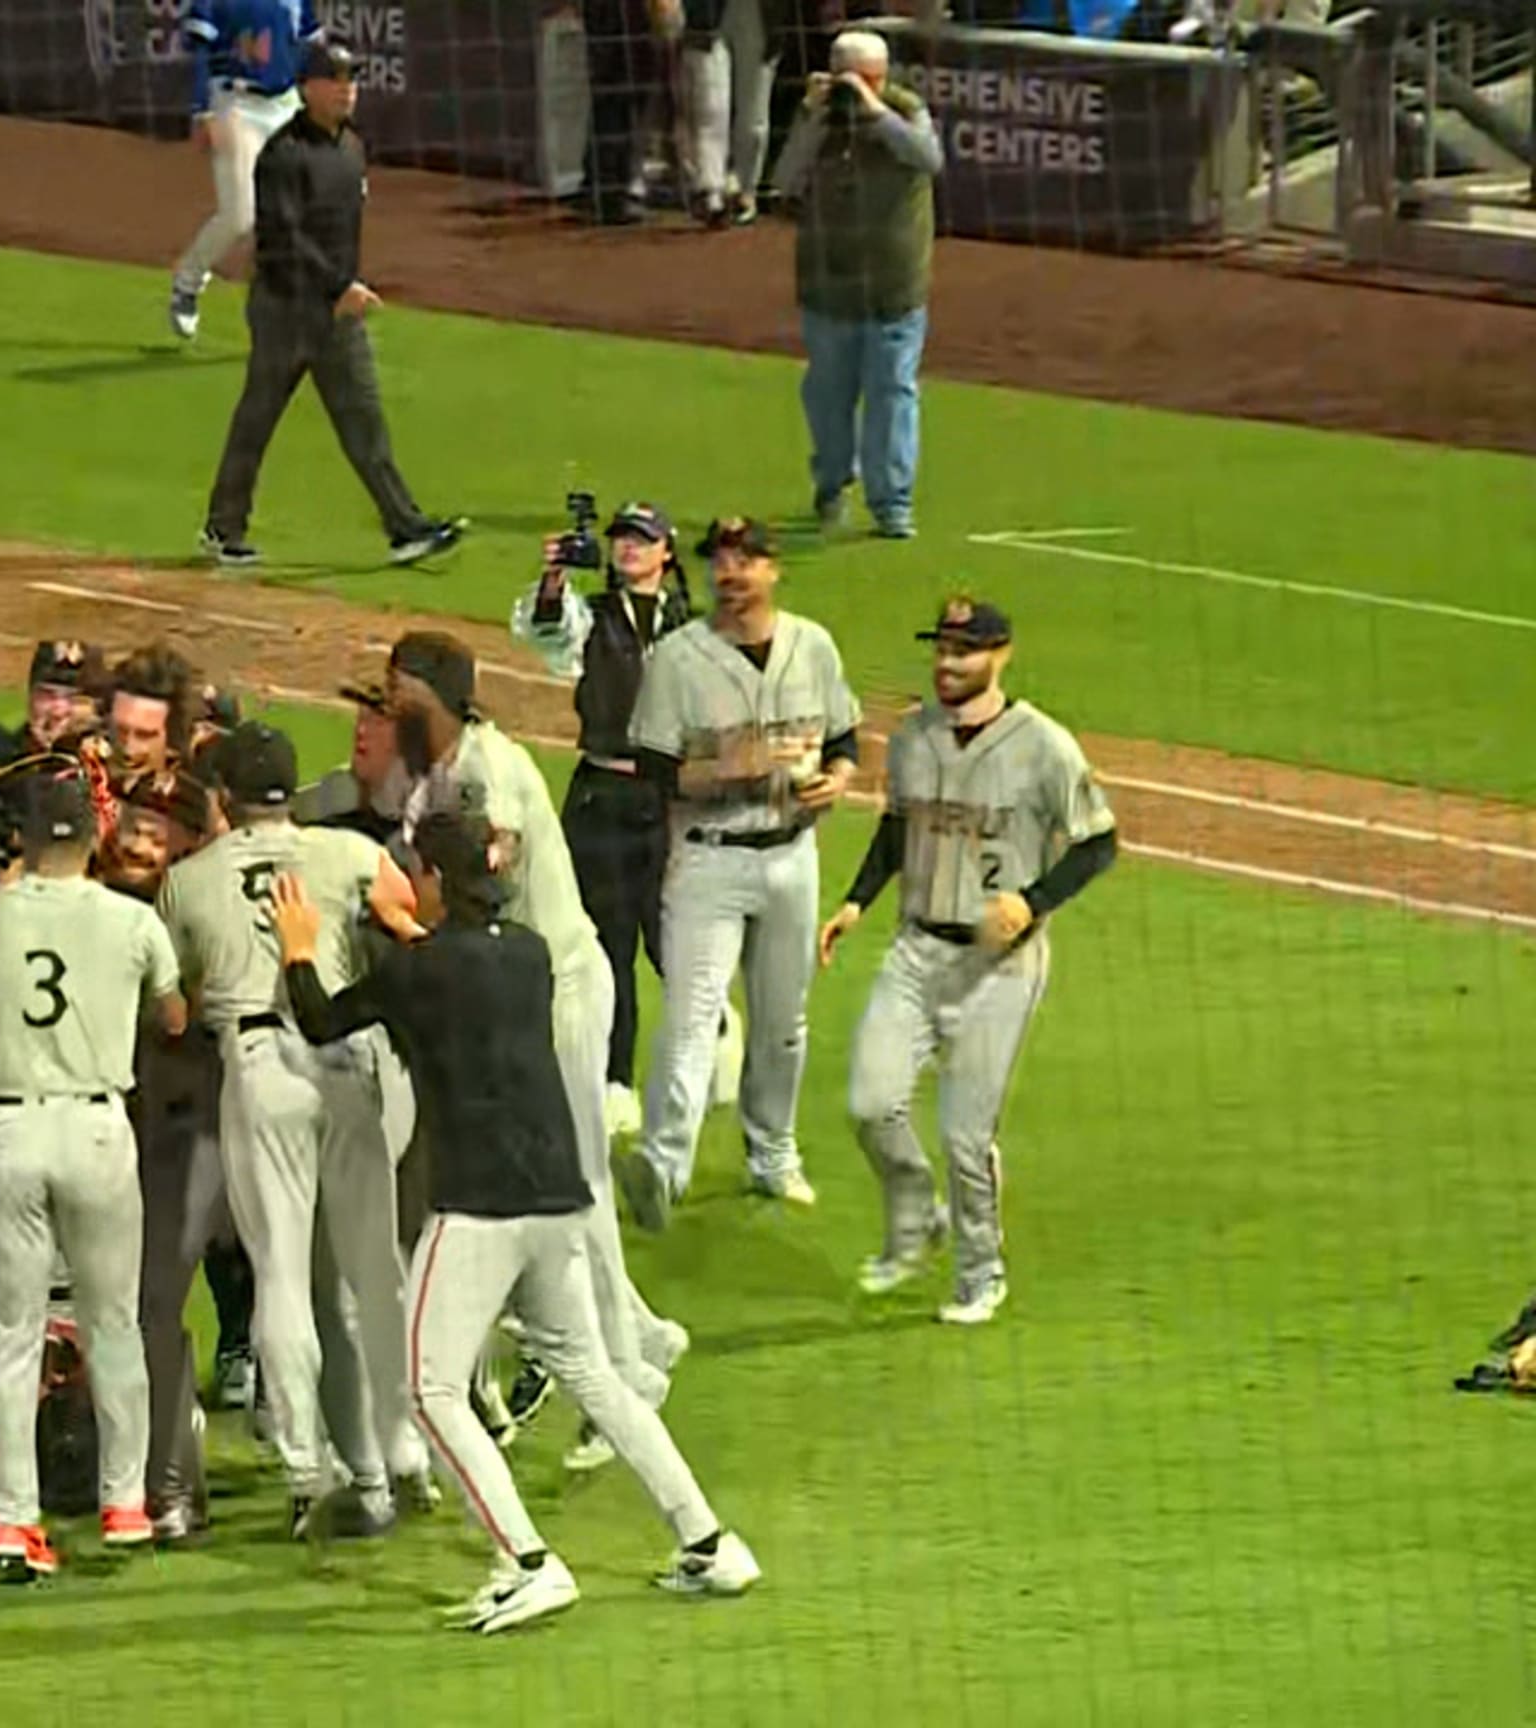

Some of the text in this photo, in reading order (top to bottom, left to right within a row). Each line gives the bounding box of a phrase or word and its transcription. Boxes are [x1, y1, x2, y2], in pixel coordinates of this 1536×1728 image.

[953, 119, 1105, 174] CENTERS
[980, 852, 1002, 890] 2
[22, 949, 69, 1029] 3
